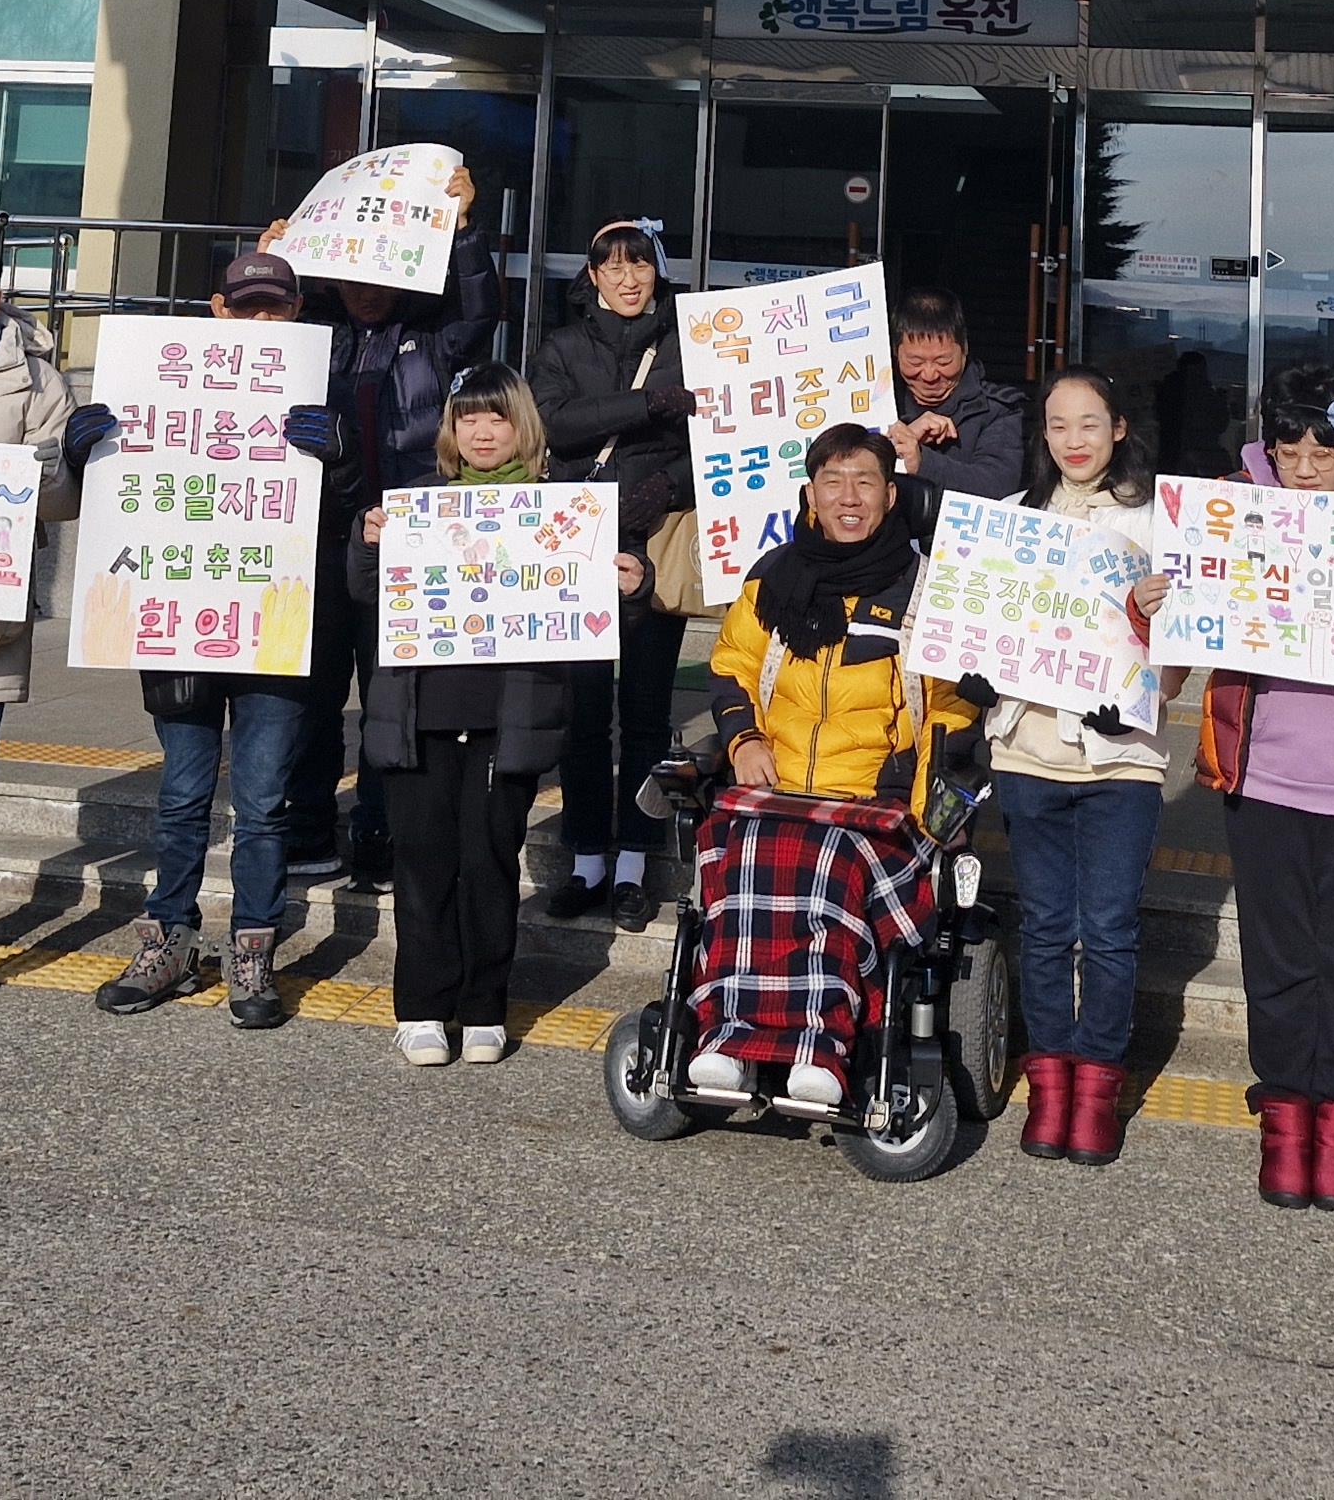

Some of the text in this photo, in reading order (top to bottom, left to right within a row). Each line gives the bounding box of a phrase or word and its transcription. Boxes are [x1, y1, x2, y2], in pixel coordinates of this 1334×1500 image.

[341, 150, 410, 183] 옥천군
[357, 196, 452, 231] 공공일자리
[286, 232, 425, 277] 사업추진 환영
[712, 281, 871, 364] 옥천군
[157, 341, 287, 395] 옥천군
[695, 355, 876, 434] 권리중심
[118, 404, 290, 462] 권리중심
[118, 472, 297, 524] 공공일자리
[386, 490, 542, 532] 권리중심
[945, 500, 1073, 566] 권리중심
[111, 543, 273, 582] 사업추진
[385, 562, 579, 611] 중증장애인
[1161, 552, 1290, 602] 권리중심
[928, 563, 1101, 630] 중증장애인
[135, 597, 261, 658] 환영!
[386, 611, 580, 659] 공공일자리
